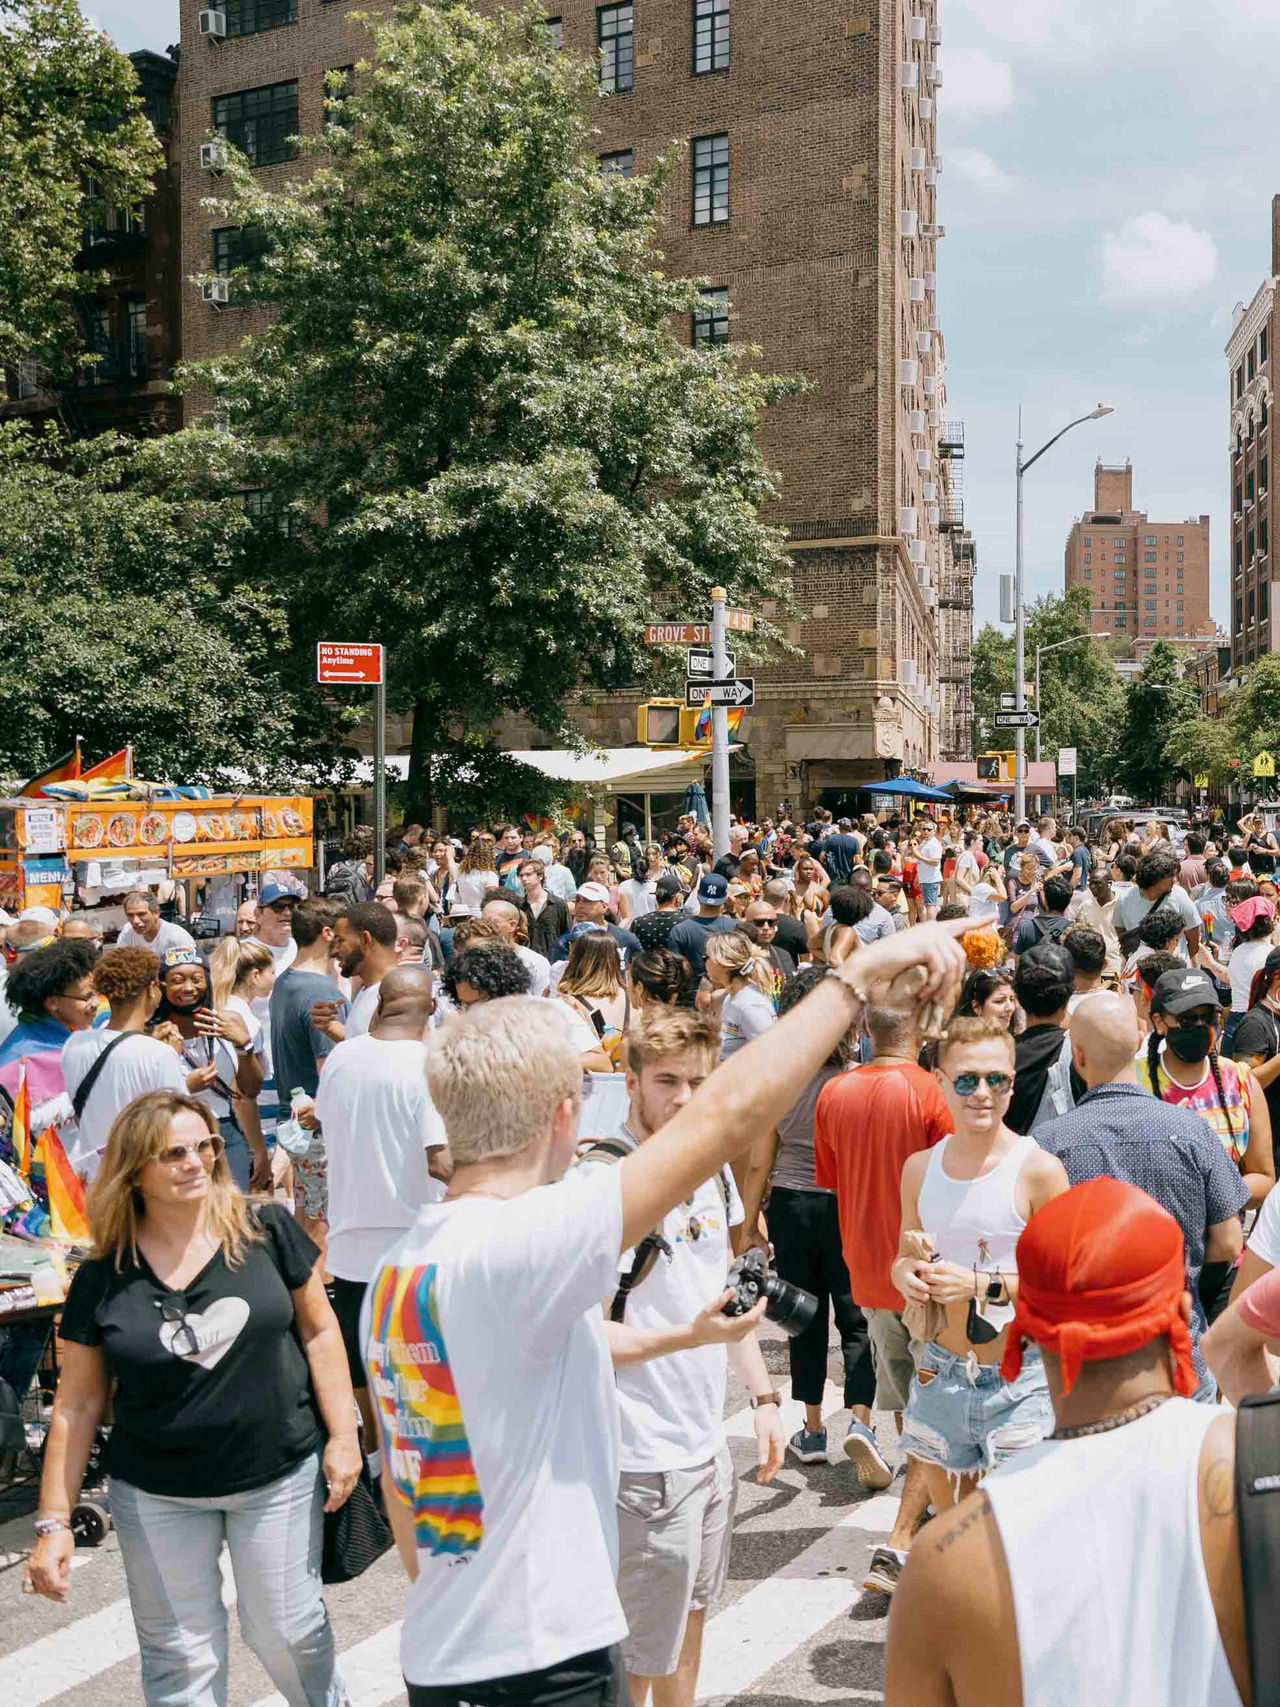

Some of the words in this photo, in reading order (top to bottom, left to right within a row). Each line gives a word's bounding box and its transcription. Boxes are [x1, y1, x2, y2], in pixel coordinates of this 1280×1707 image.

[742, 613, 751, 630] ST
[649, 626, 686, 642] GROVE
[693, 626, 707, 642] ST
[322, 647, 333, 656] NO
[334, 647, 373, 657] STANDING
[322, 656, 354, 666] Anytime
[692, 657, 707, 669] ONE
[722, 687, 745, 698] WAY
